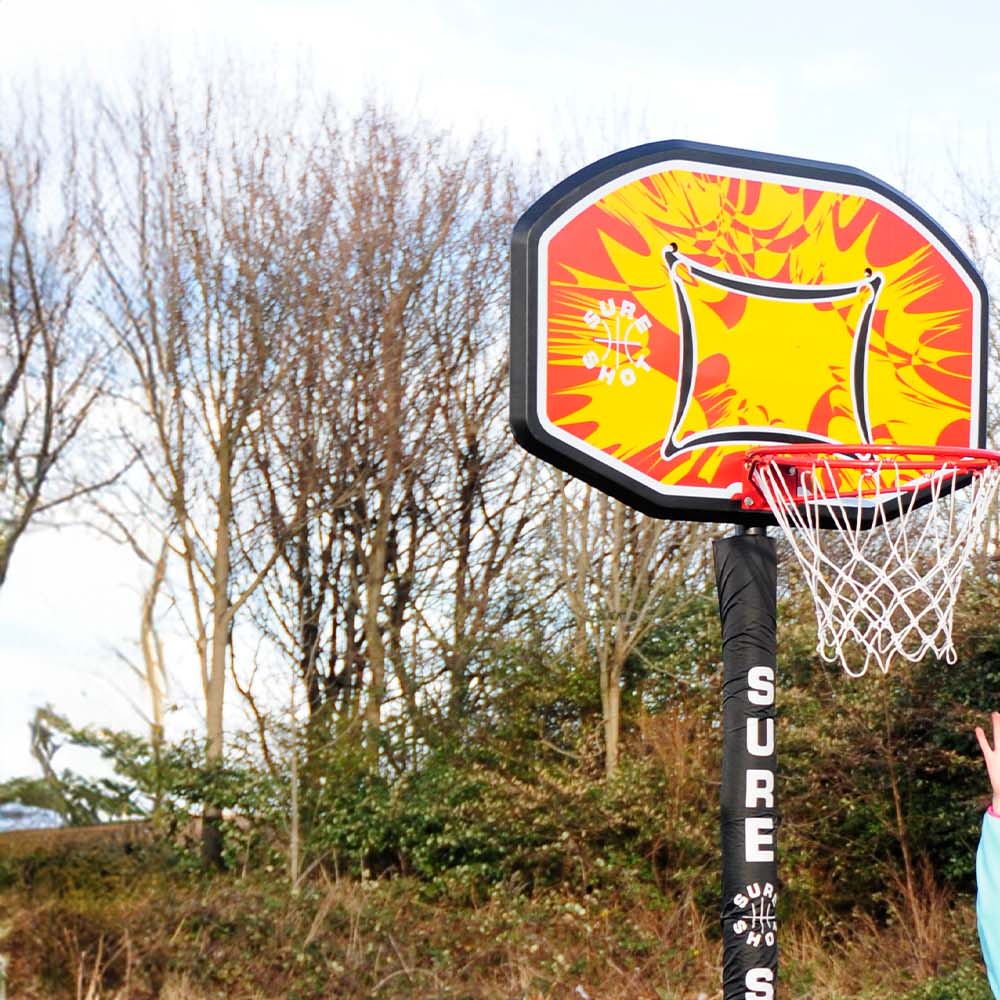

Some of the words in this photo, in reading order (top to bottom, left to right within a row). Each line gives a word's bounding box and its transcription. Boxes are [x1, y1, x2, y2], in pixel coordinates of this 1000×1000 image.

[583, 298, 652, 334] SURE
[582, 350, 651, 387] SHOT
[745, 666, 775, 863] SURE
